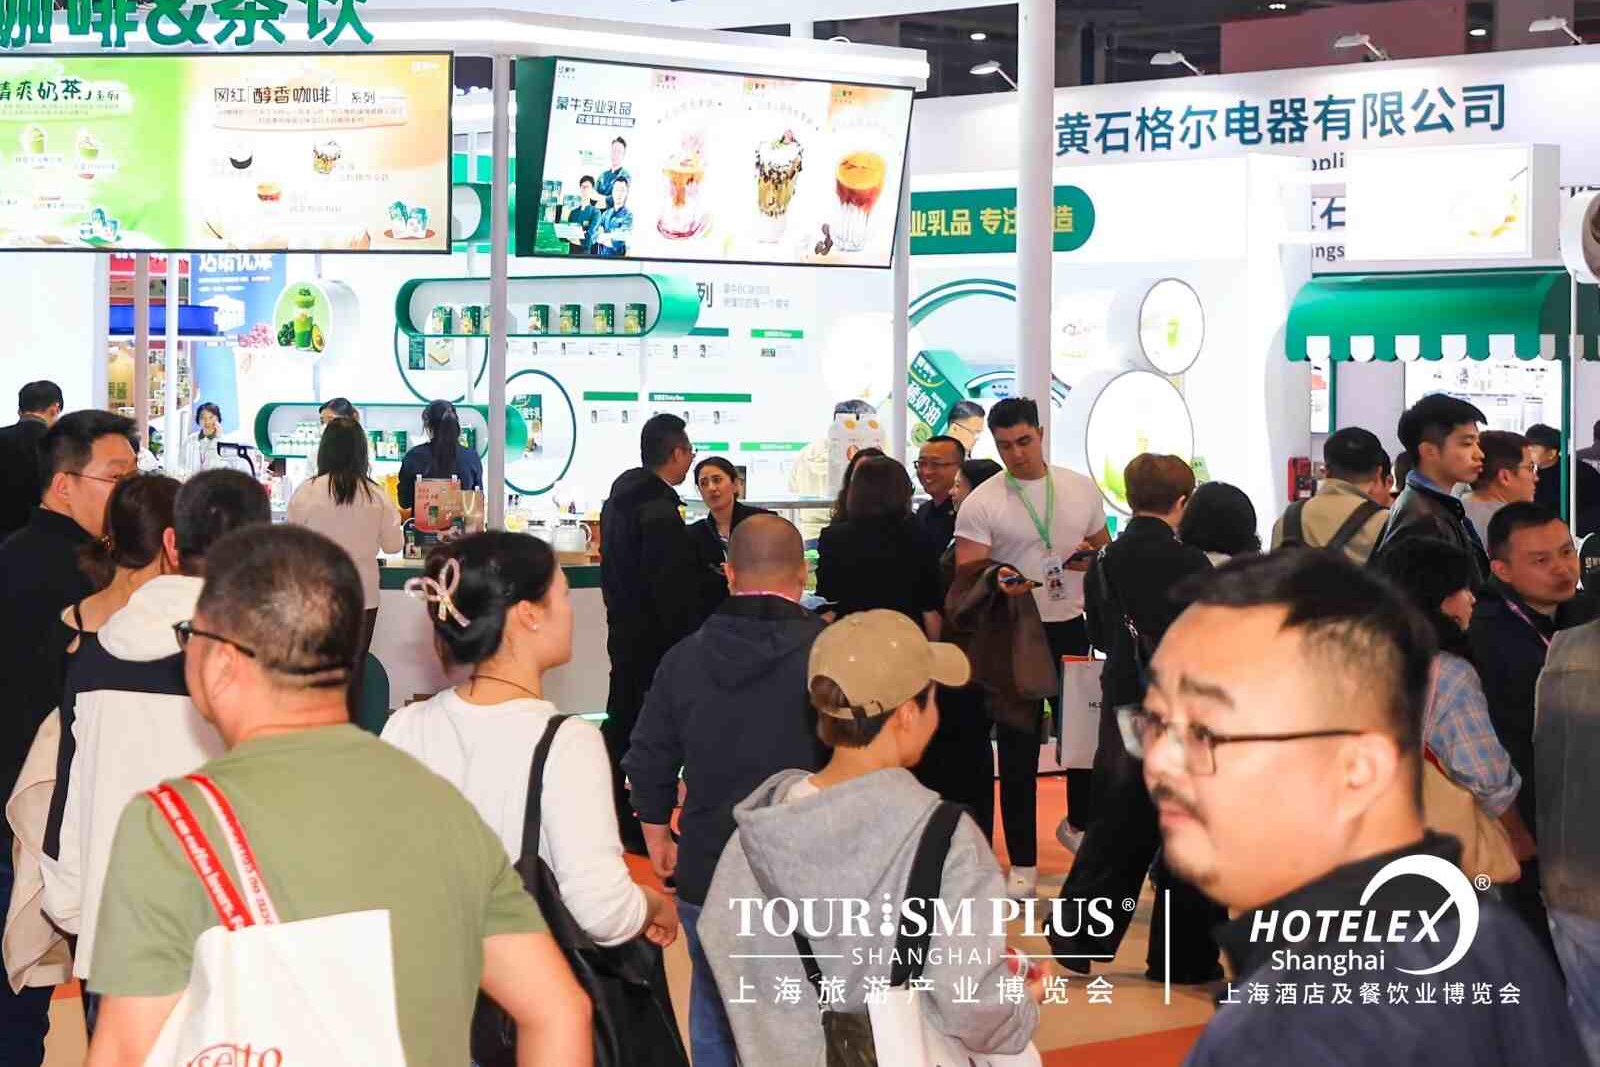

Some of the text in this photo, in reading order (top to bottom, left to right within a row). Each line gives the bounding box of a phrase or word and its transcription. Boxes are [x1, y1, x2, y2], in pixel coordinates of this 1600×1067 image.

[1055, 83, 1506, 159] 黄石格尔电器有限公司
[980, 204, 1073, 235] 专注造
